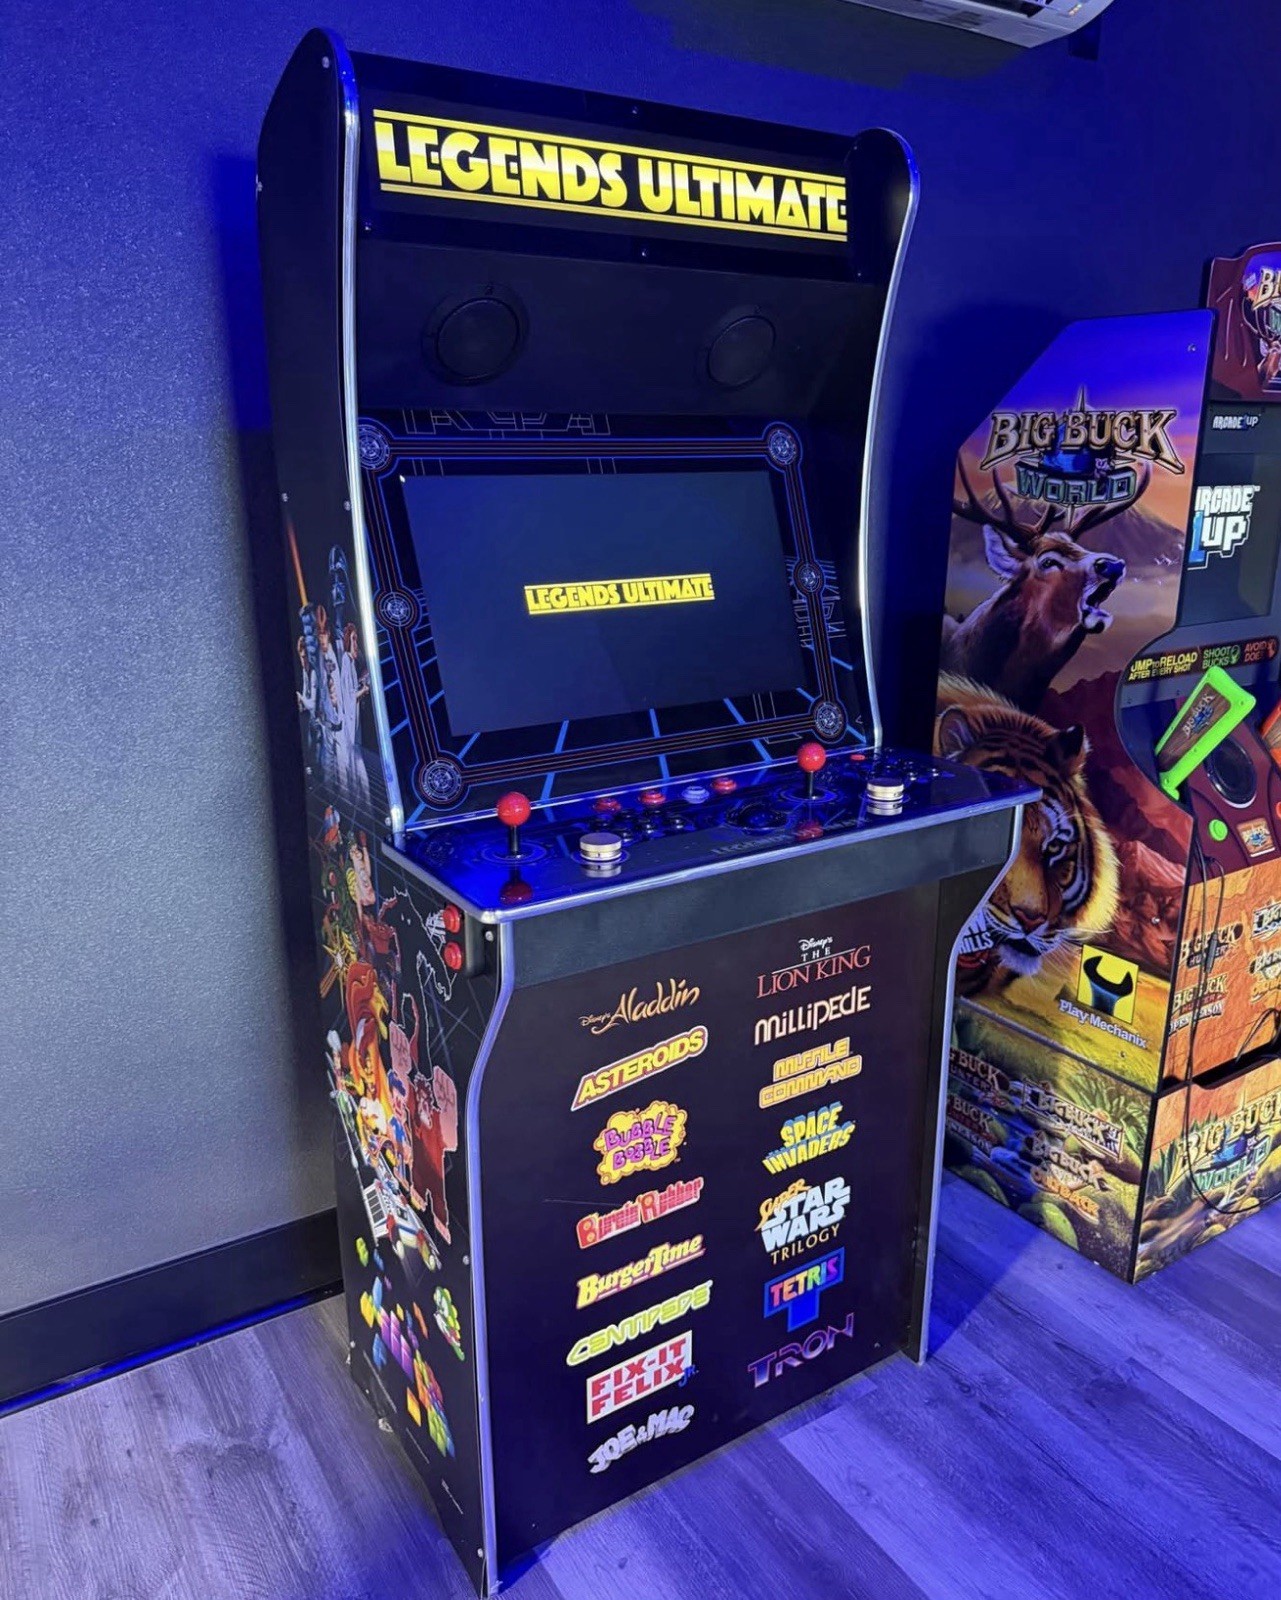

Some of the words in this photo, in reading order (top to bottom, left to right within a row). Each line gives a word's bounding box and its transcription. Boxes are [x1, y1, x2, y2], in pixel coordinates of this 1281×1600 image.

[374, 121, 628, 208] LEGENDS
[638, 158, 847, 233] ULTIMATE
[1252, 268, 1281, 309] BI
[980, 412, 1057, 471] BIG
[1064, 410, 1185, 474] BUCK
[1016, 465, 1137, 506] WORLD
[525, 582, 620, 610] LEGENDS
[621, 576, 714, 604] ULTIMATE
[1128, 670, 1150, 680] AFTER
[1174, 664, 1191, 673] SHOT
[1160, 652, 1198, 667] RELOAD
[1202, 657, 1230, 669] BUCKS
[1203, 646, 1231, 659] SHOOT
[798, 937, 833, 951] Disney's
[801, 947, 831, 962] THE
[1180, 935, 1202, 963] BG
[1203, 923, 1236, 951] BCK
[756, 965, 810, 998] LION
[815, 945, 871, 980] KING
[591, 979, 700, 1034] Aladdin
[1059, 999, 1090, 1024] Play
[1089, 1012, 1148, 1049] Mechanix
[575, 1028, 706, 1107] ASTEROIDS
[759, 1055, 862, 1108] COMMAND
[774, 1037, 850, 1080] MISSILE
[959, 1050, 1003, 1091] BUCK
[604, 1112, 677, 1151] BUBBLE
[762, 1121, 856, 1174] INVADERS
[780, 1101, 843, 1148] SPACE
[613, 1136, 671, 1170] BOBBLE
[1165, 1123, 1225, 1195] BIG
[1195, 1136, 1272, 1191] WORLD
[761, 1177, 851, 1231] STAR
[761, 1194, 851, 1253] WARS
[770, 1223, 840, 1265] TRILOGY
[770, 1257, 840, 1307] TETRIS
[566, 1280, 713, 1366] CENTIPEDE
[591, 1337, 687, 1398] FIX-IT
[748, 1312, 854, 1388] TRON
[591, 1357, 685, 1417] FELIX
[587, 1424, 638, 1473] JOE
[637, 1425, 648, 1445] &
[646, 1404, 695, 1441] MAC
